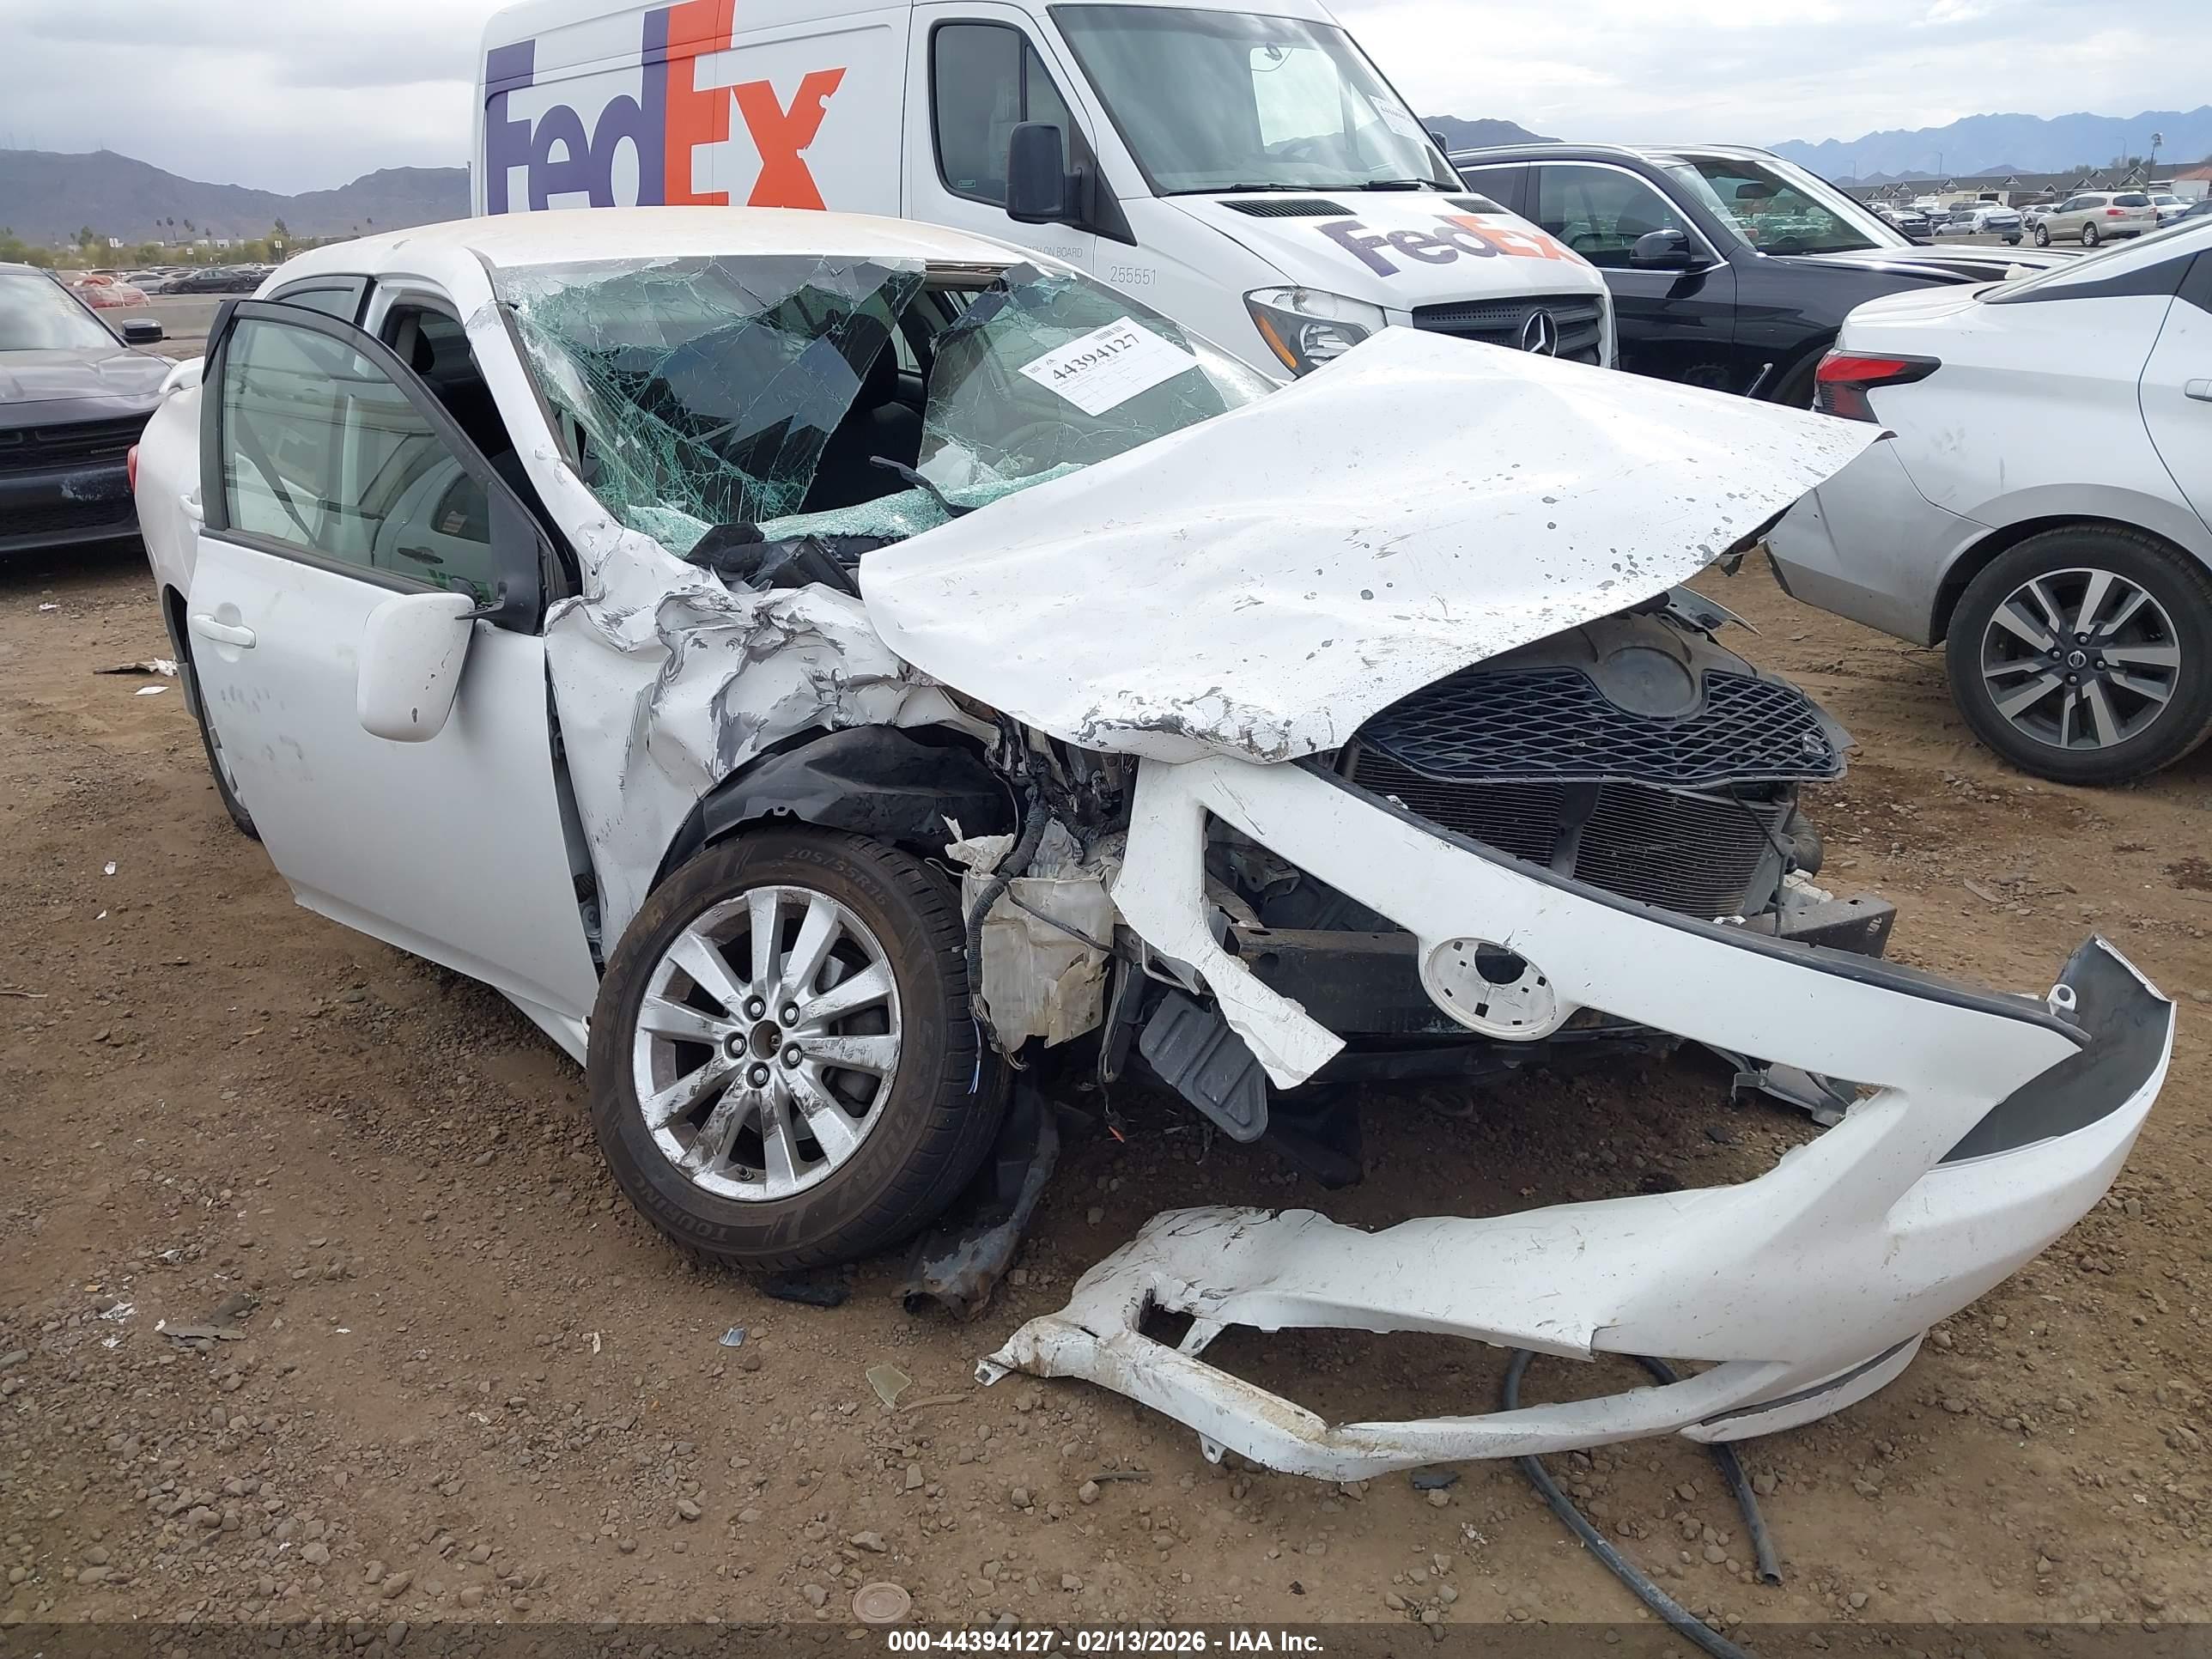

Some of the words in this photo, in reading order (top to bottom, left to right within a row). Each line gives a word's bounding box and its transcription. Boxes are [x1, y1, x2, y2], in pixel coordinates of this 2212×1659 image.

[486, 0, 847, 215] FedEx
[1056, 246, 1084, 258] BOARD
[1316, 215, 1585, 277] FedEx
[1110, 266, 1158, 285] 255551
[1053, 333, 1140, 380] 44394127
